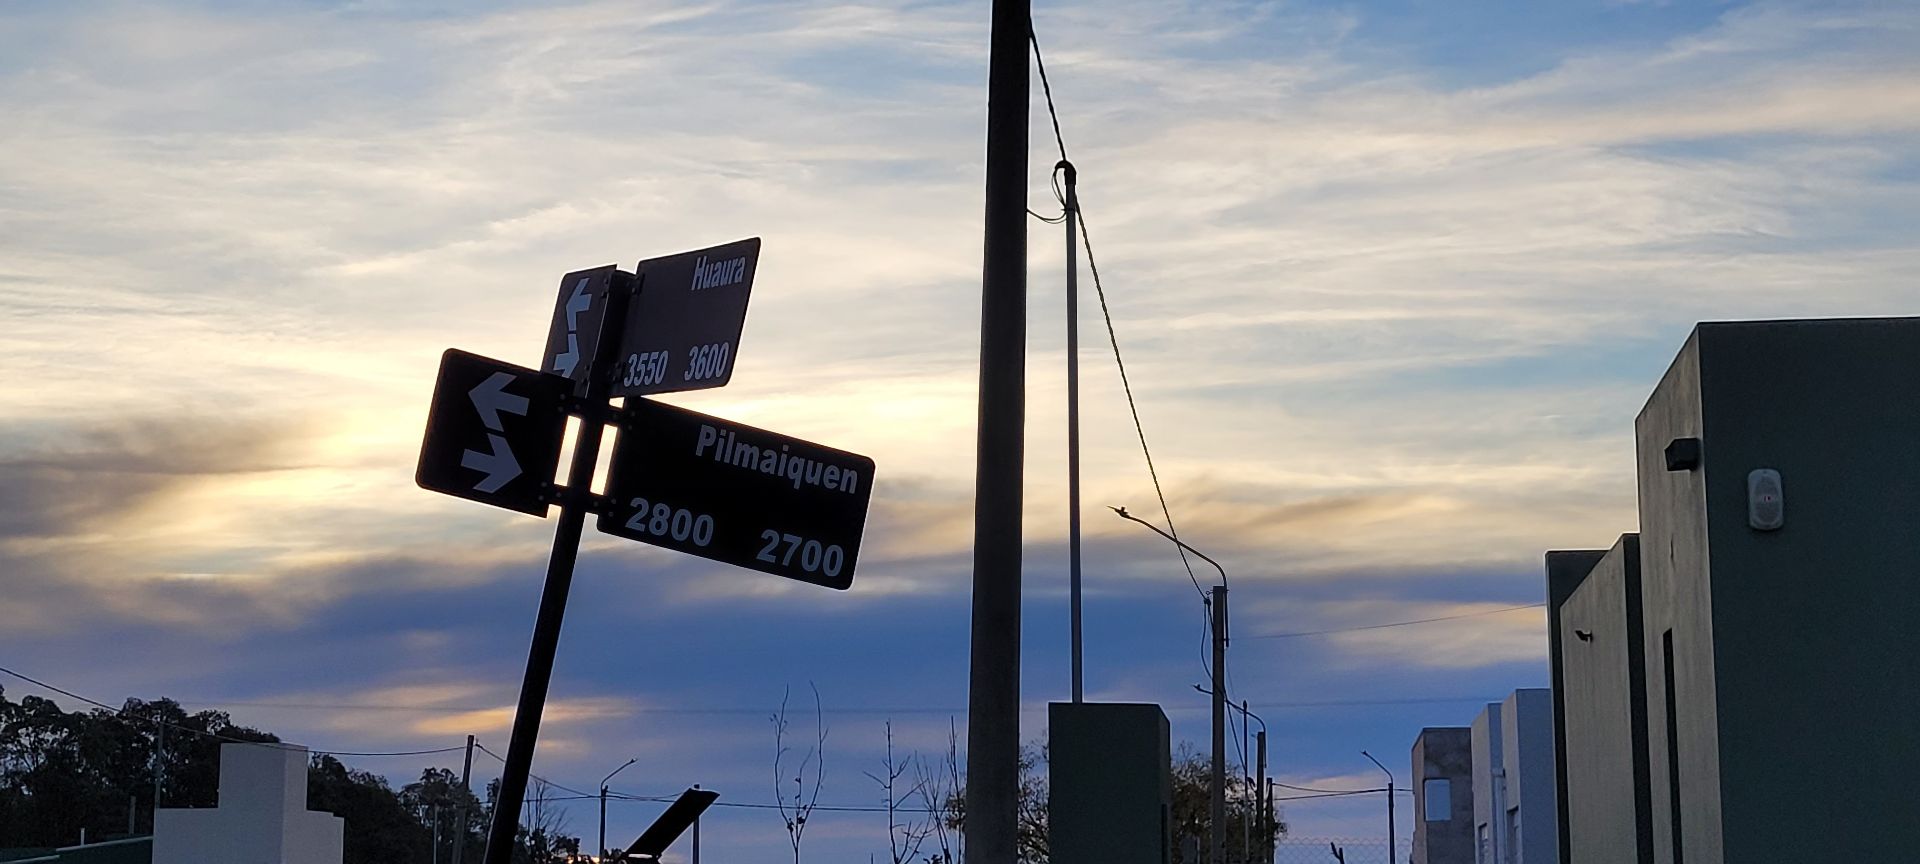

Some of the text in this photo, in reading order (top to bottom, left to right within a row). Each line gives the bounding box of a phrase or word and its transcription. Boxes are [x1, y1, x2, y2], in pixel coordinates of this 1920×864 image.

[691, 255, 746, 291] Huaura
[624, 342, 729, 387] 3550 3600
[695, 424, 858, 494] Pilmaiquen
[625, 497, 844, 577] 2800 2700
